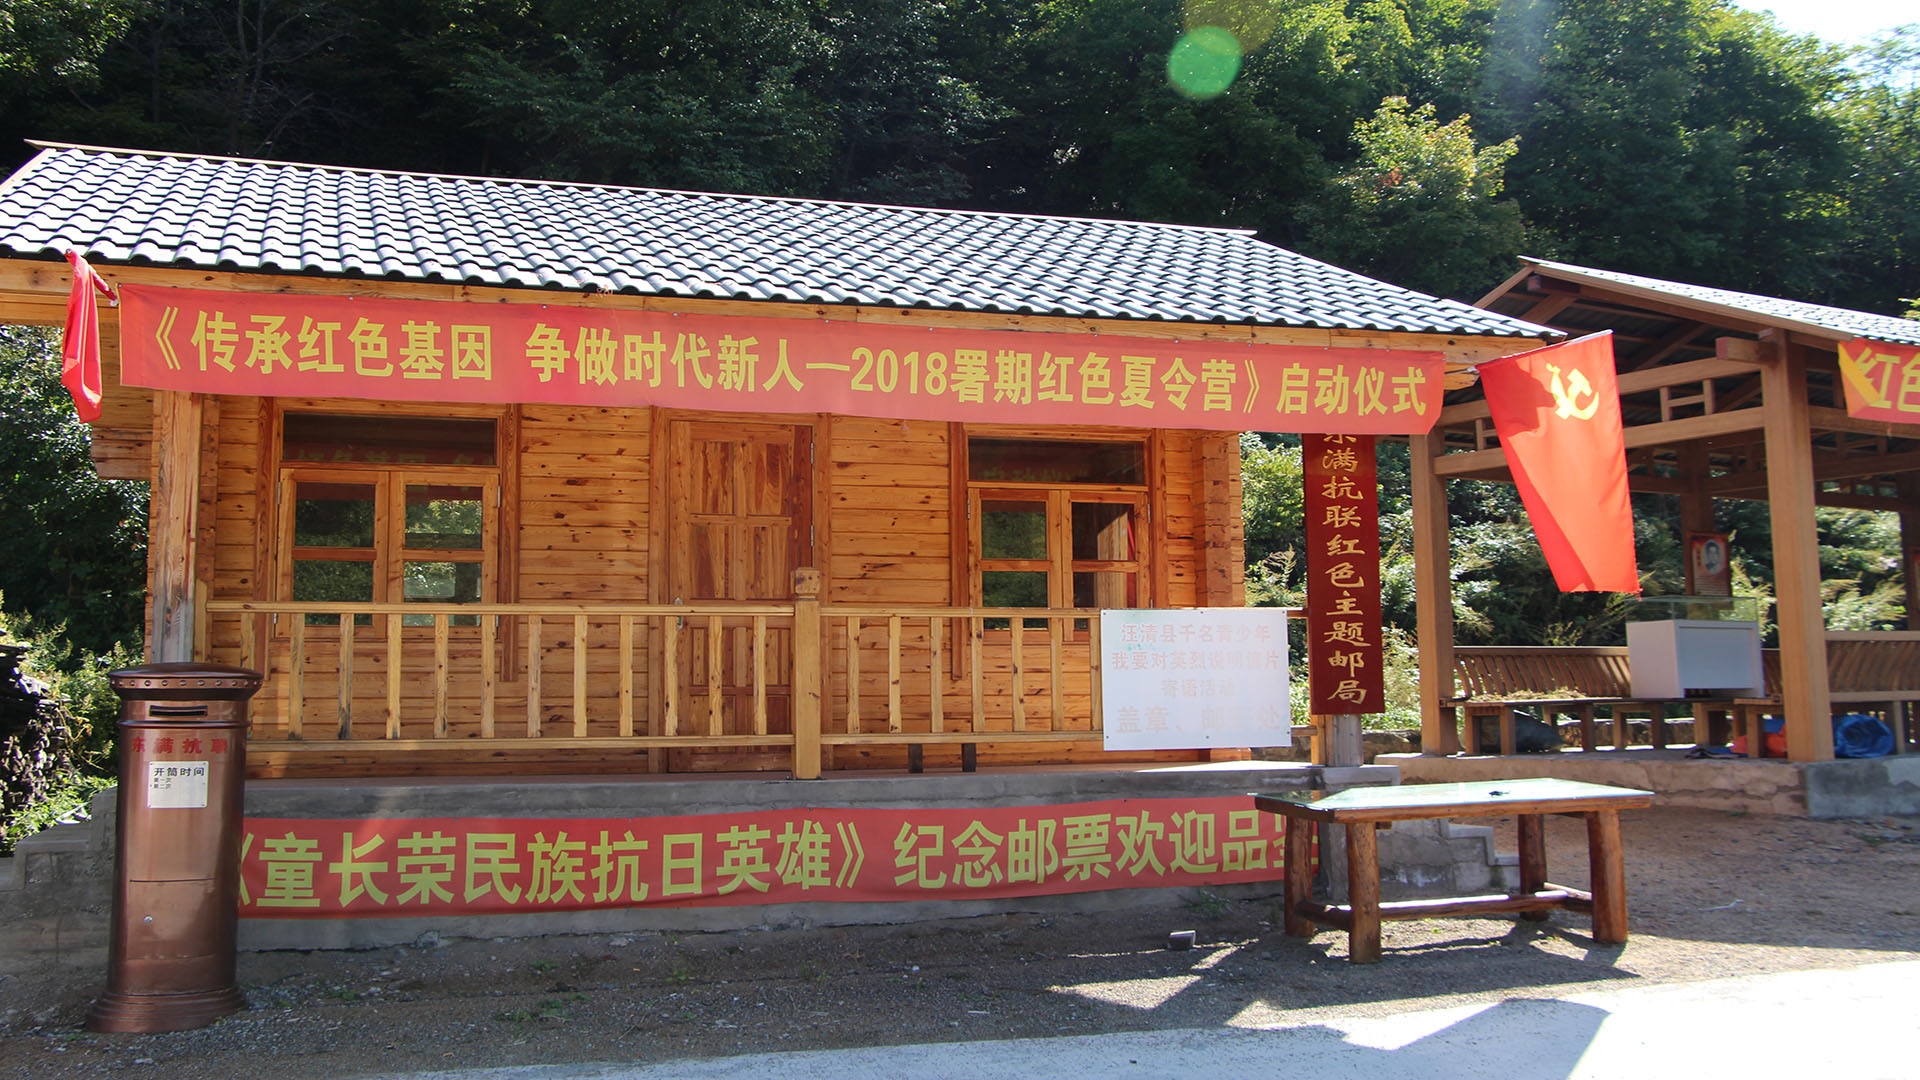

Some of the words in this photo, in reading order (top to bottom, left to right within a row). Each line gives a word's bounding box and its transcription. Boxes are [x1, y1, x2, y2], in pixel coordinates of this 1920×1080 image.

[155, 305, 493, 381] 《传承红色基因
[131, 737, 227, 753] 东满抗联
[153, 766, 205, 777] 开筒时间
